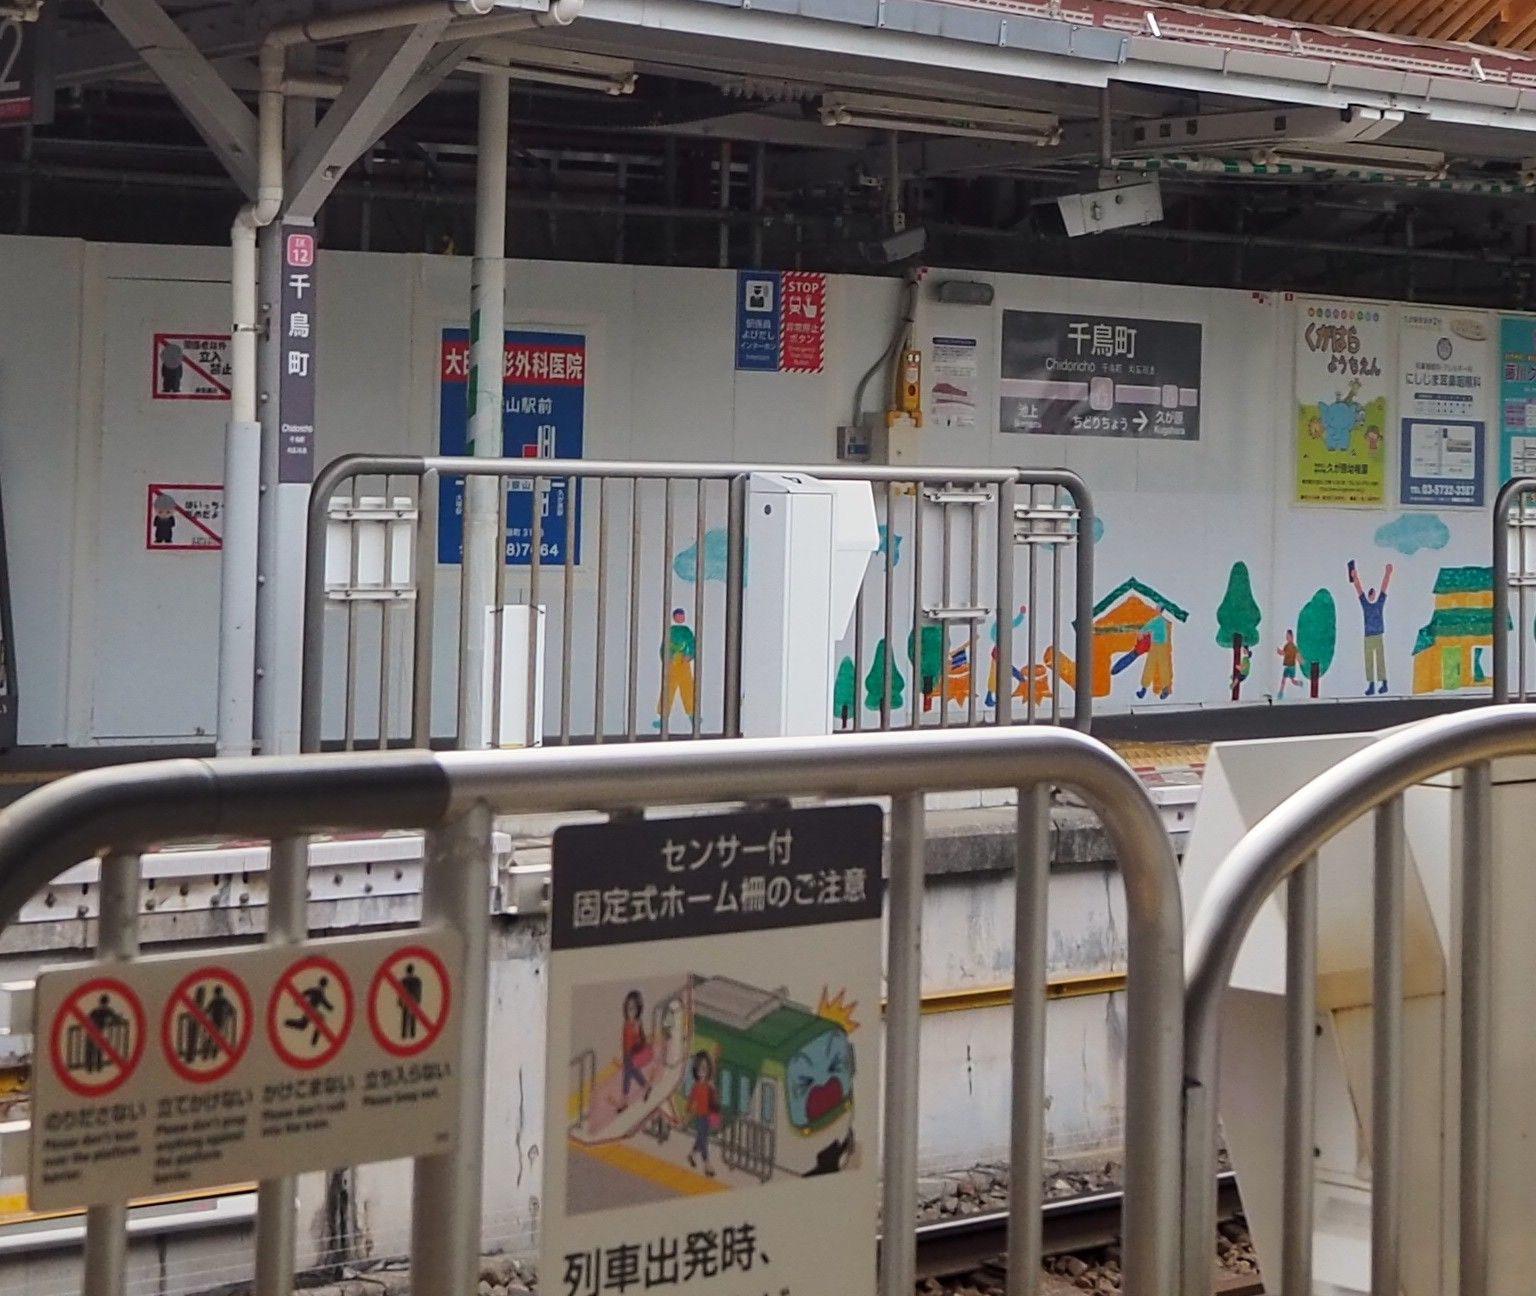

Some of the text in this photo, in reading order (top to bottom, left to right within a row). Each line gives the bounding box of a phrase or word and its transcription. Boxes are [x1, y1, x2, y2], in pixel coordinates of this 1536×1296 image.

[292, 249, 308, 263] 12
[788, 281, 820, 294] STOP
[288, 273, 311, 377] 千鳥町
[742, 330, 775, 340] よびだし
[790, 334, 815, 344] ボタン
[1067, 322, 1137, 359] 千鳥町
[1304, 322, 1360, 354] くがはら
[198, 351, 222, 363] 立入
[1045, 357, 1097, 374] Chidoricho
[1327, 354, 1381, 377] ようちえん
[209, 363, 232, 376] 禁止
[1018, 404, 1039, 419] 池上
[1155, 410, 1185, 425] 久が原
[1072, 415, 1129, 431] ちどりちょう
[661, 827, 794, 873] センサー付
[572, 867, 868, 929] 固定式ホーム柵のご注意
[364, 1060, 452, 1090] 立ち入らない
[263, 1075, 355, 1102] かけこまない
[45, 1102, 148, 1131] のりださない
[563, 1222, 771, 1296] 列車出発時、
